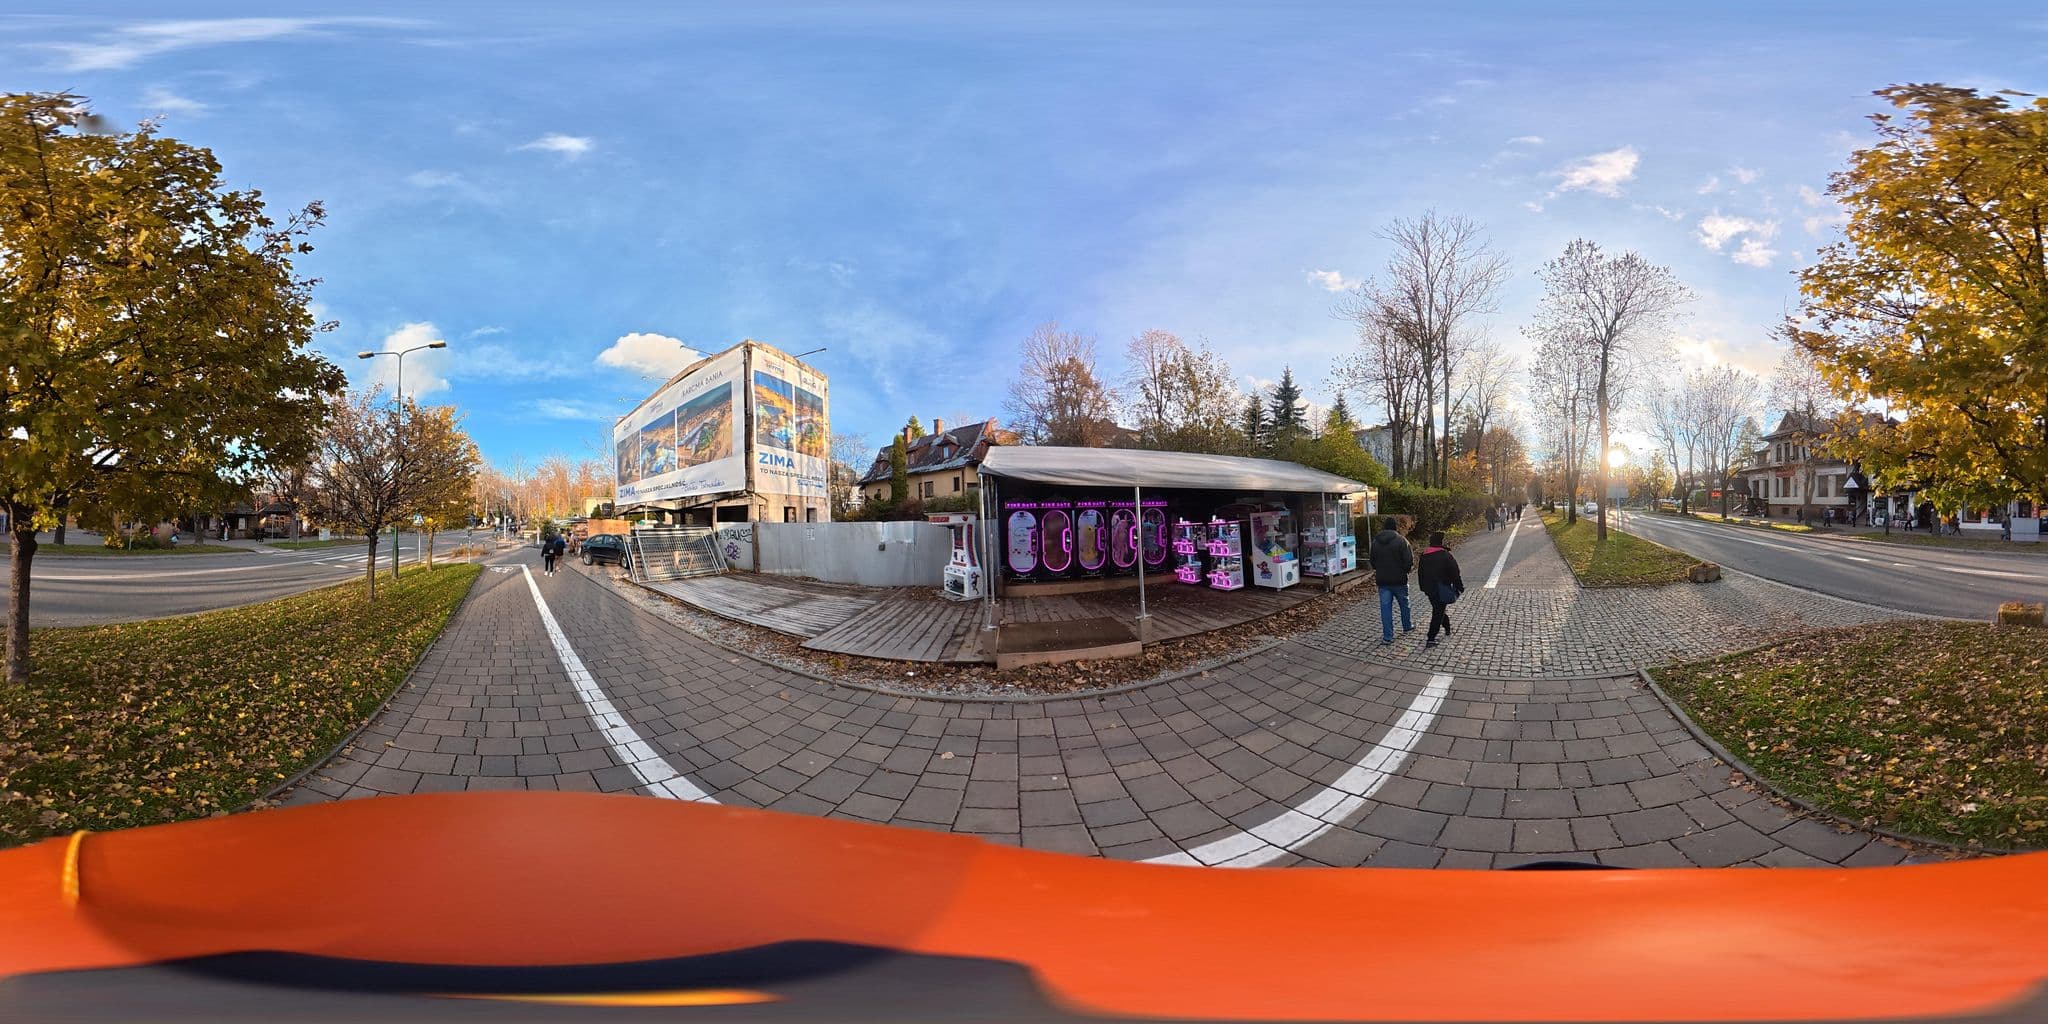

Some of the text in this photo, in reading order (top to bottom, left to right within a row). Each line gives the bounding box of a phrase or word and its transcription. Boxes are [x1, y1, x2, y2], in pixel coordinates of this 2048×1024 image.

[759, 452, 795, 469] ZIMA
[769, 469, 789, 477] NASZA
[619, 486, 636, 498] ZIMA
